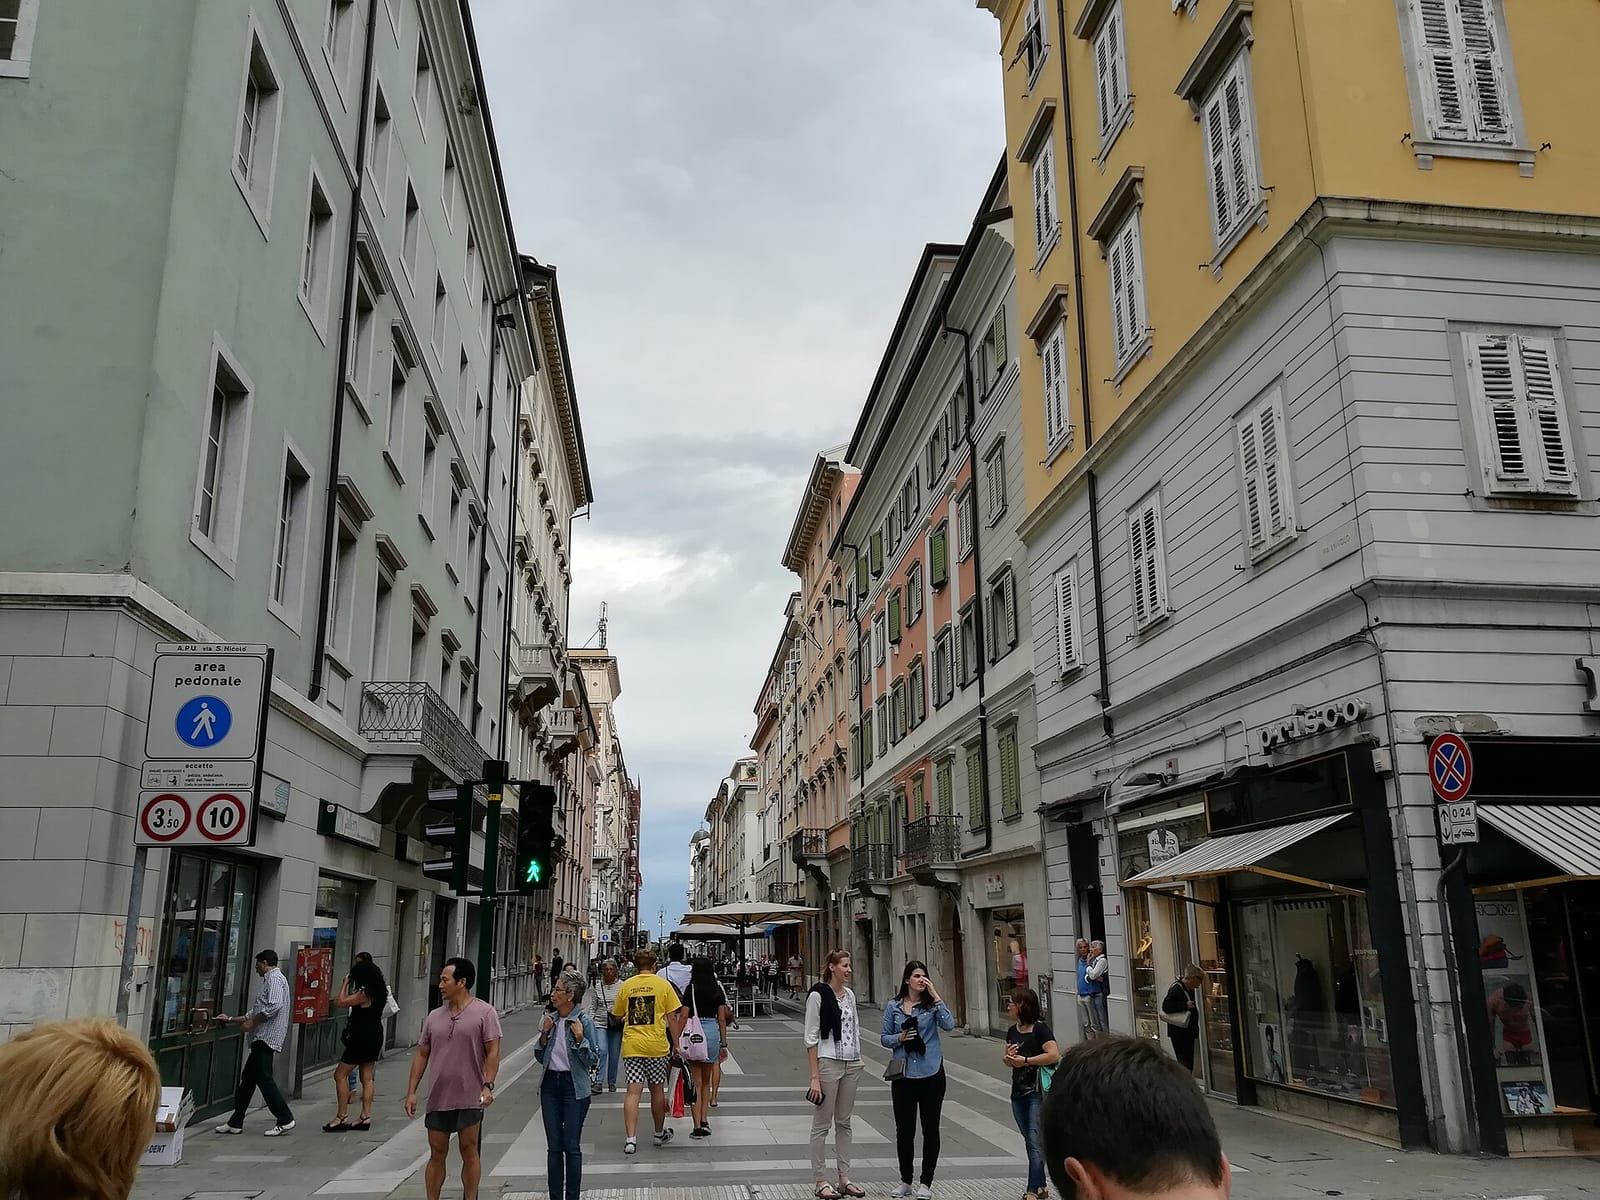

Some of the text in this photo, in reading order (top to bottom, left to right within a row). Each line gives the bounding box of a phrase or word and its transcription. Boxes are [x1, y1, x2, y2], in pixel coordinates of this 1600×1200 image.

[194, 663, 226, 672] area
[174, 675, 242, 688] pedonale
[1257, 698, 1364, 755] prisco
[209, 806, 234, 829] 10
